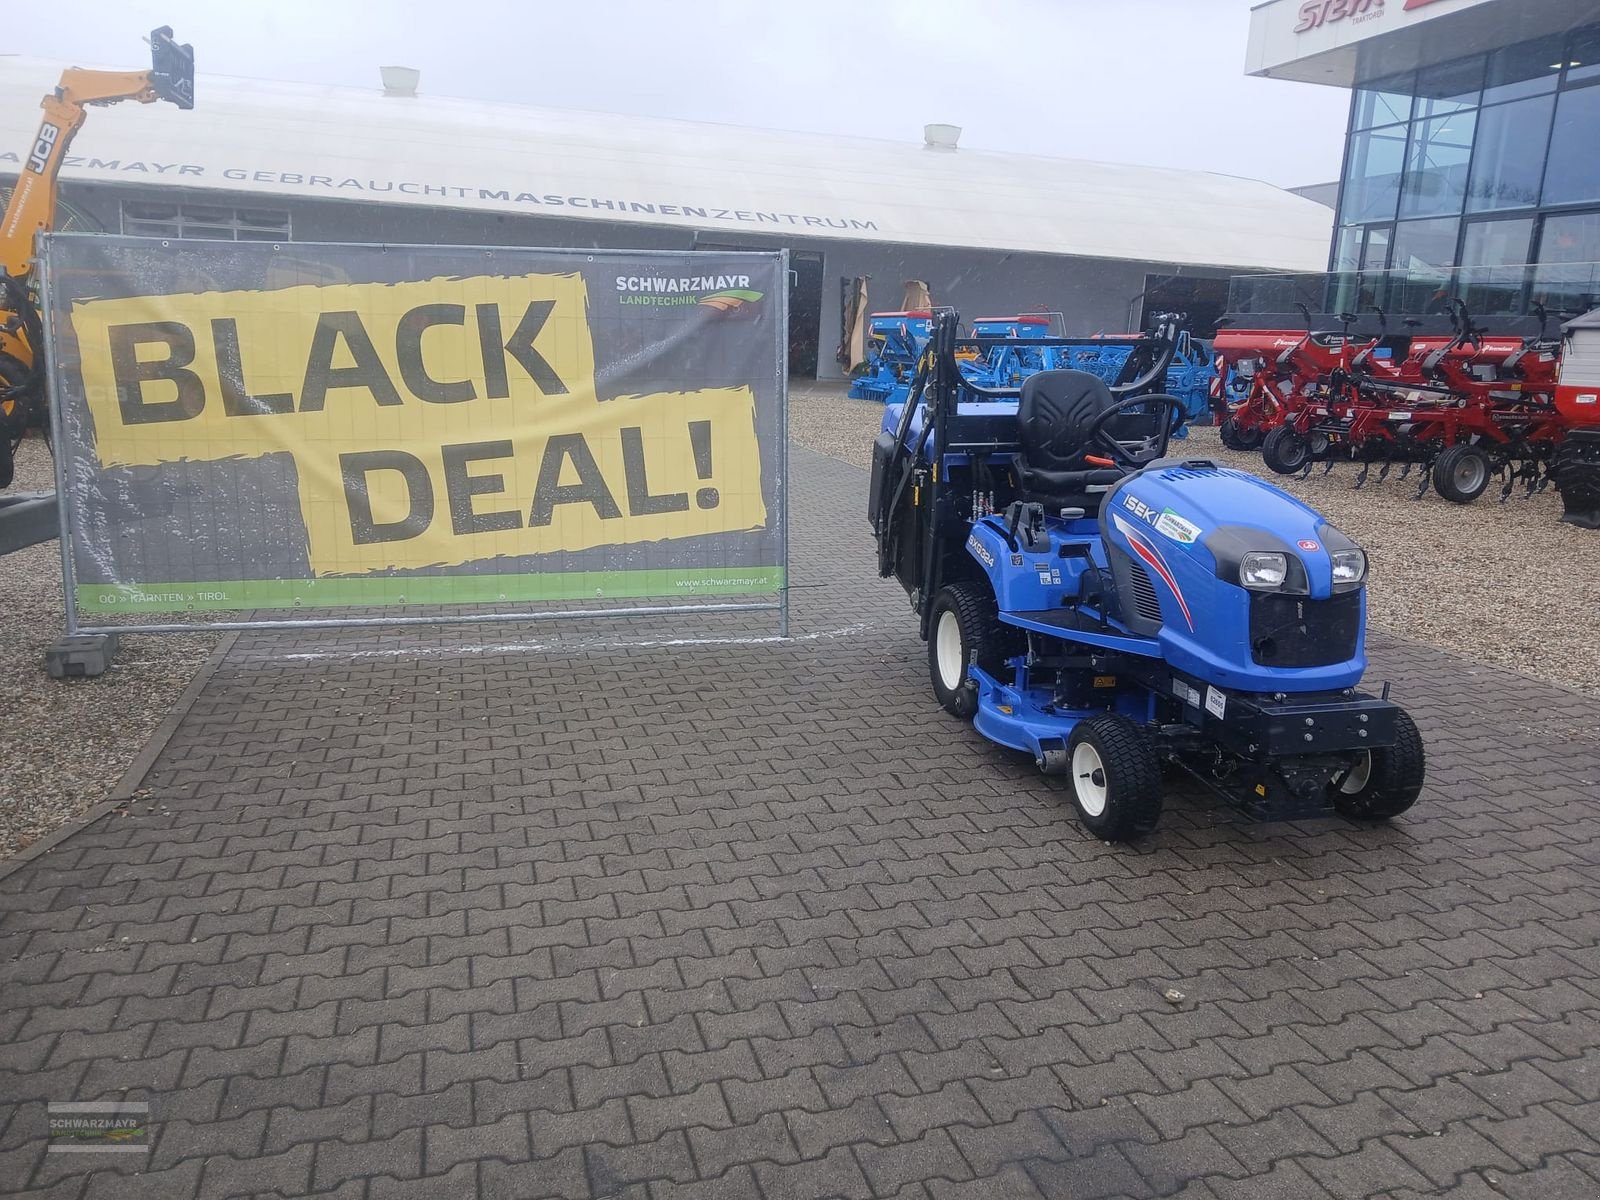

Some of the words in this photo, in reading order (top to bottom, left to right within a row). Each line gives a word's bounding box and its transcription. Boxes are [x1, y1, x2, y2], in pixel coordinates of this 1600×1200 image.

[1293, 0, 1385, 33] STE
[1352, 9, 1385, 25] TRAKTOREN
[29, 123, 59, 174] JCB
[0, 151, 205, 176] AZMAYR
[223, 168, 878, 231] GEBRAUCHTMASCHINENZENTRUM
[616, 275, 750, 292] SCHWARZMAYR
[619, 295, 697, 306] LANDTECHNIK
[108, 300, 569, 426] BLACK
[339, 420, 720, 546] DEAL!
[1123, 494, 1160, 526] ISEKI
[968, 534, 995, 568] SXG324
[197, 591, 229, 601] TIROL
[675, 577, 768, 587] www.schwarzmayr.at
